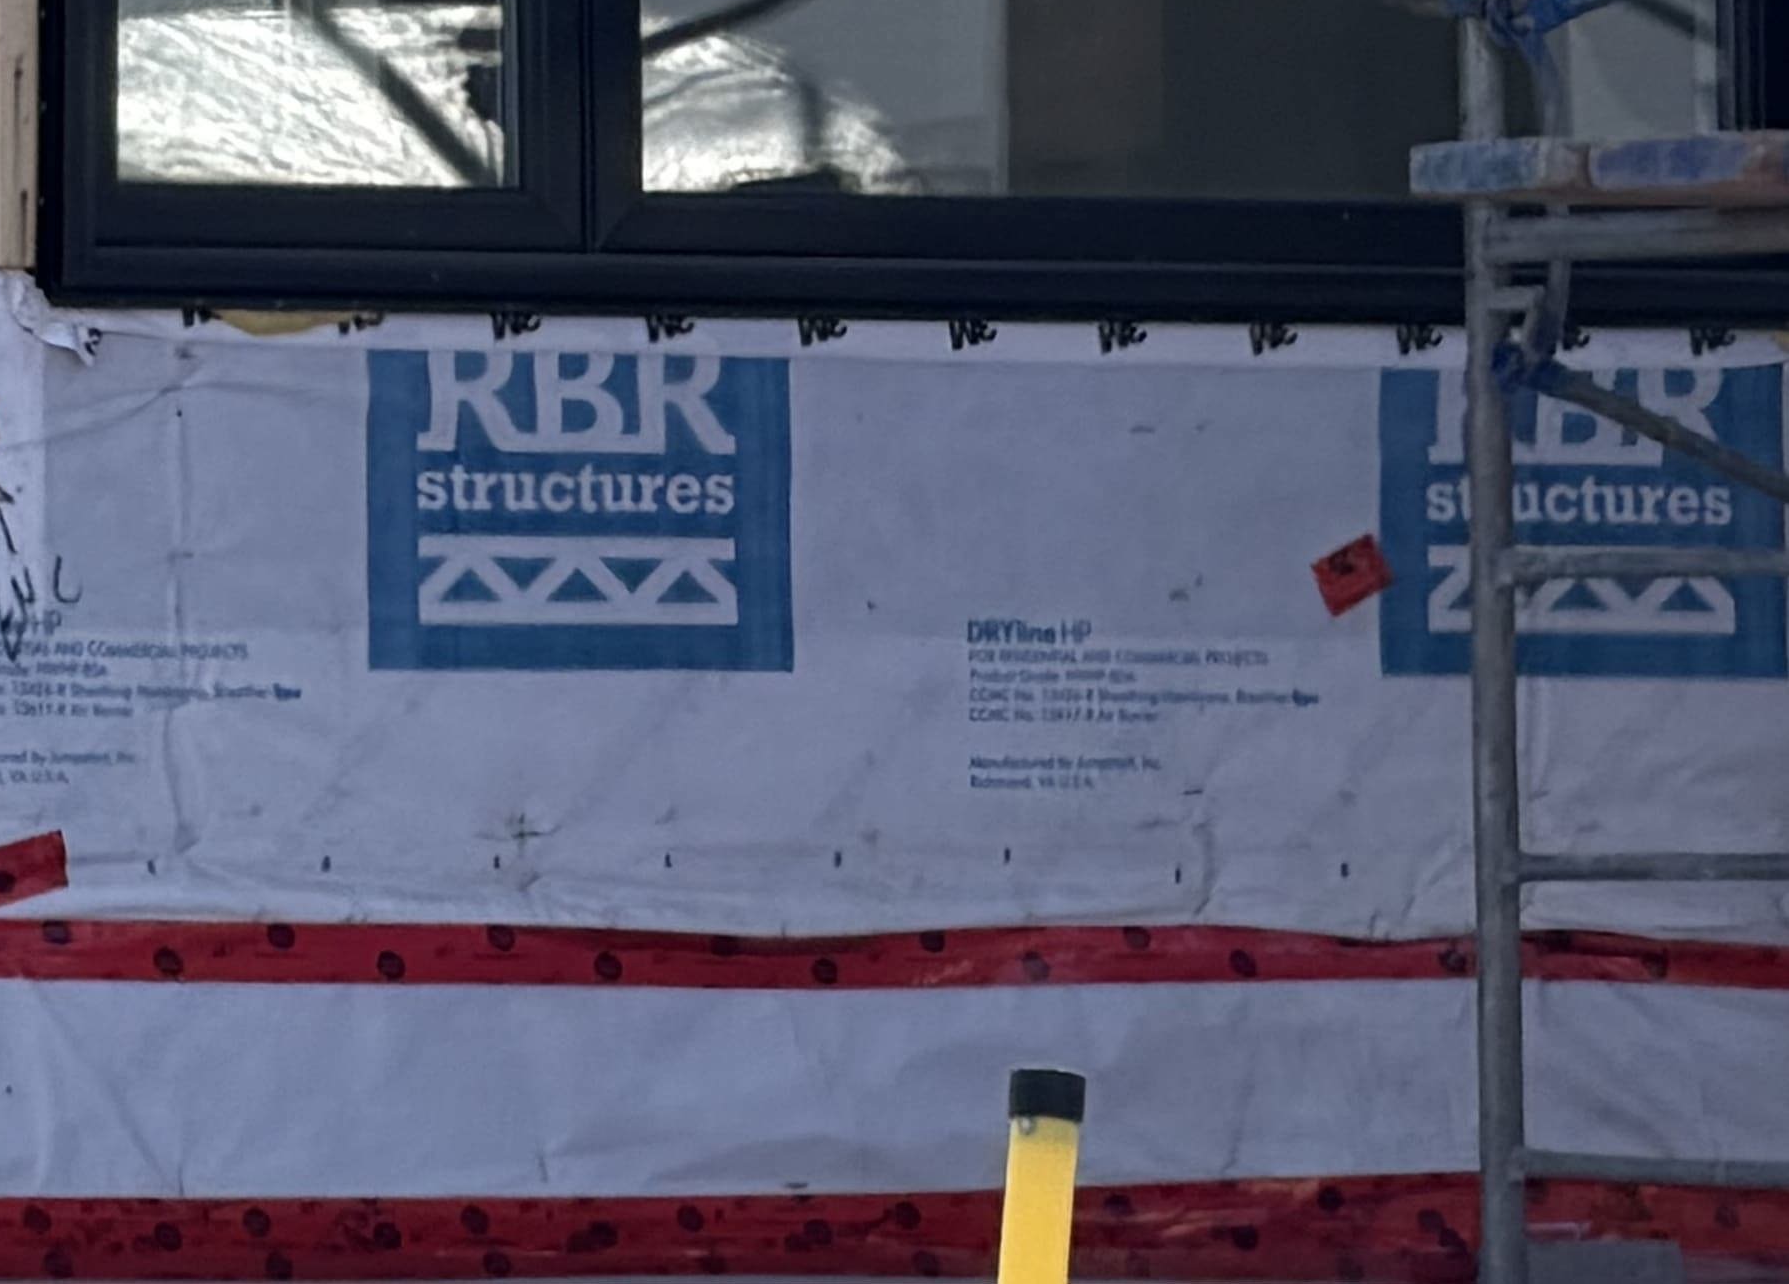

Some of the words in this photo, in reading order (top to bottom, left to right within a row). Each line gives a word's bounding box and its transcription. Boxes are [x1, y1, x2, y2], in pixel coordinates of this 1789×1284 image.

[417, 341, 736, 455] RBR
[417, 464, 736, 516] structures
[967, 619, 1056, 644] DRYline
[1061, 619, 1091, 644] HP
